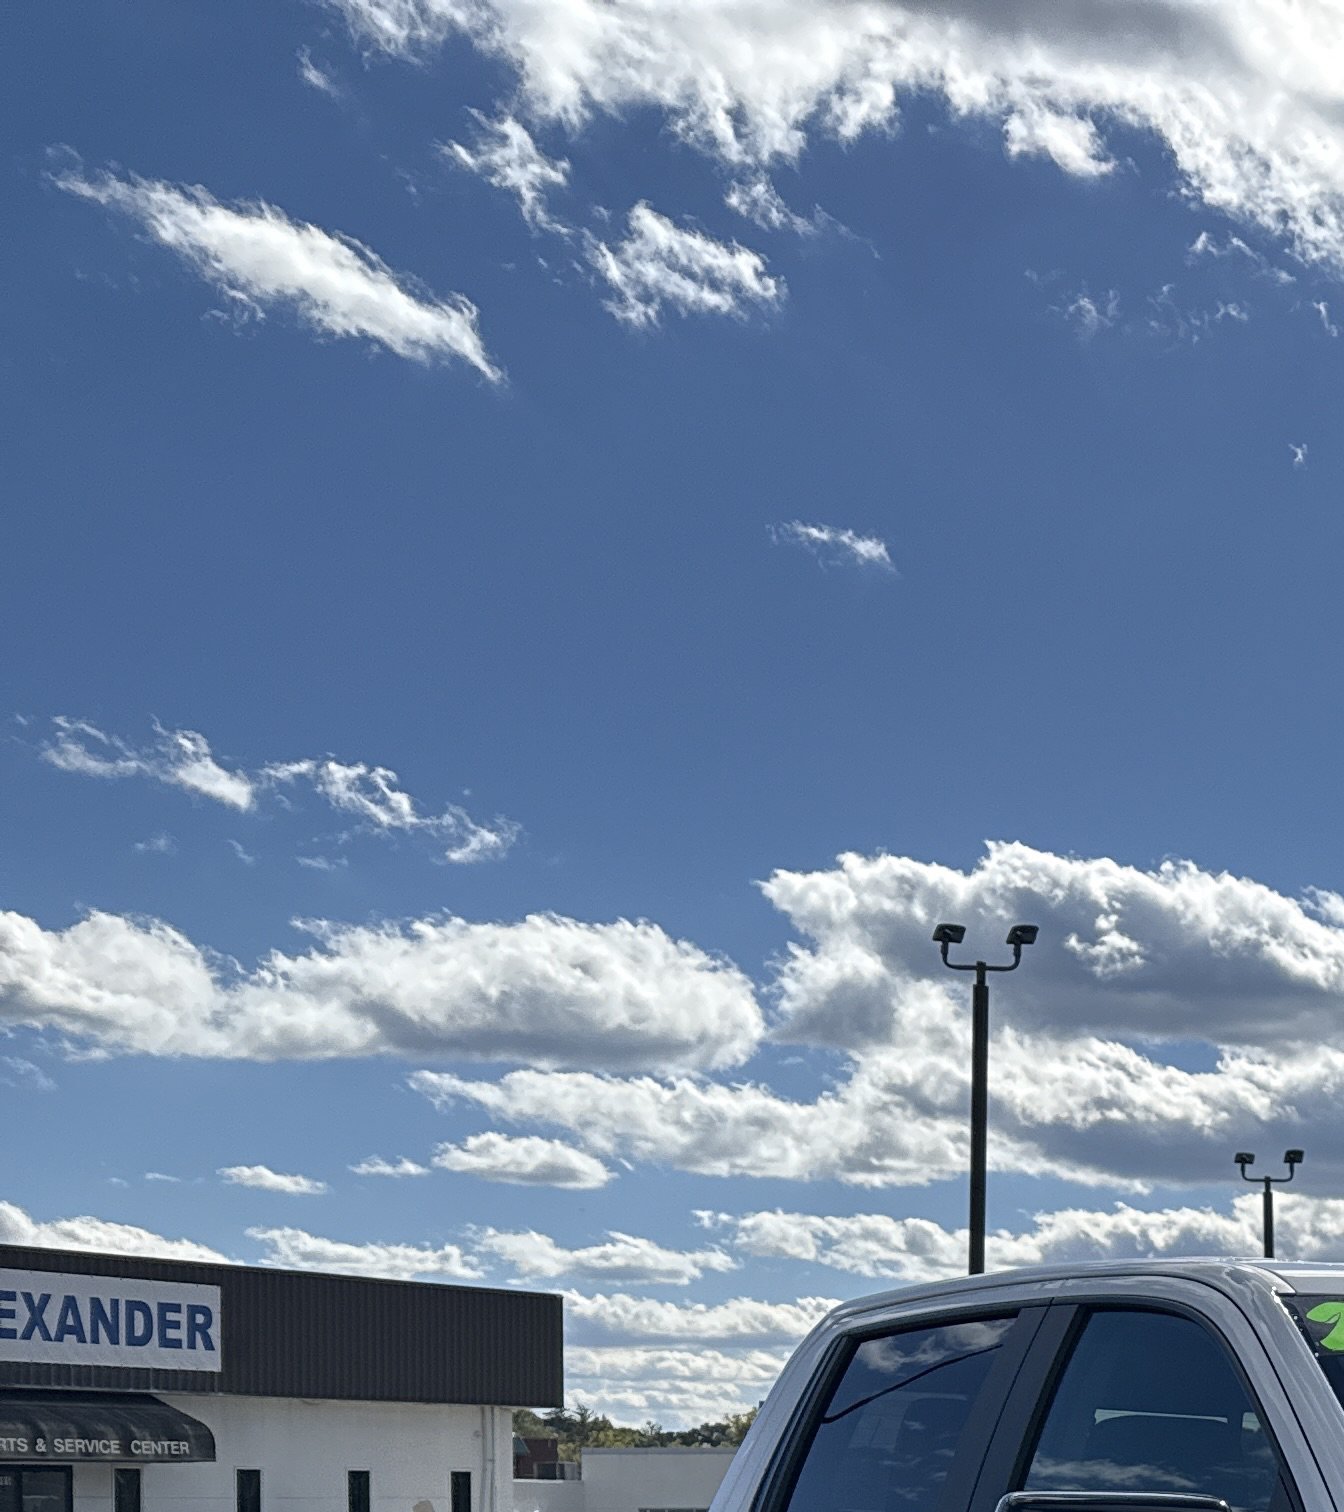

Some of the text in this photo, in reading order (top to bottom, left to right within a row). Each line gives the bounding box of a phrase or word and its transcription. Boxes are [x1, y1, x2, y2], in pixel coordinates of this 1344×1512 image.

[35, 1438, 46, 1452] &
[54, 1438, 120, 1454] SERVICE
[131, 1440, 190, 1455] CENTER
